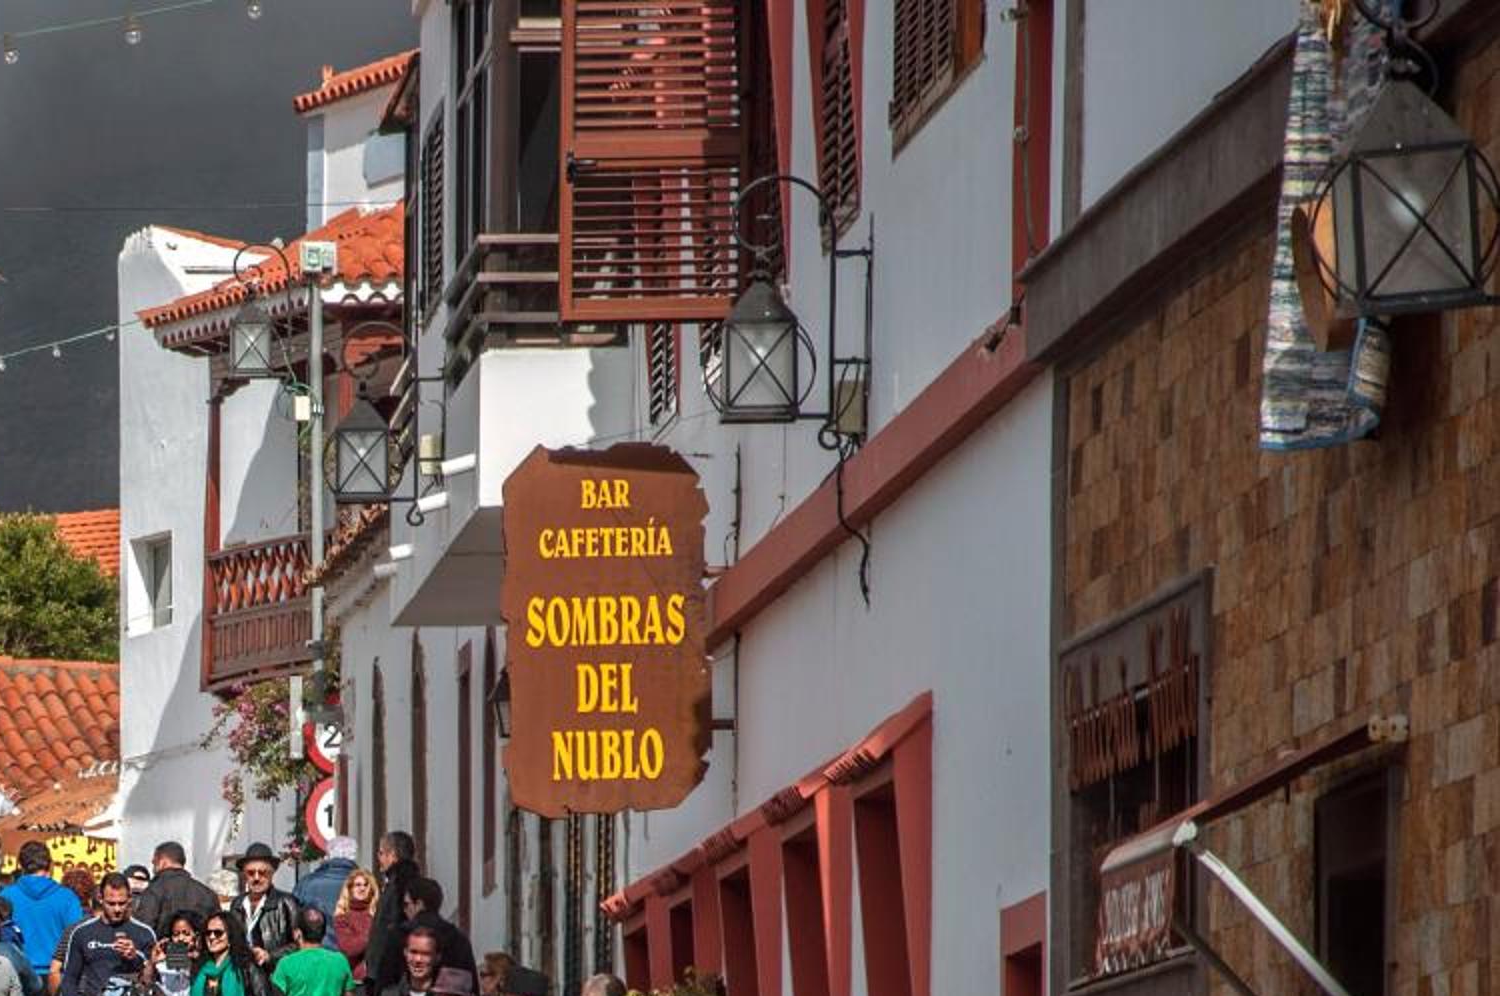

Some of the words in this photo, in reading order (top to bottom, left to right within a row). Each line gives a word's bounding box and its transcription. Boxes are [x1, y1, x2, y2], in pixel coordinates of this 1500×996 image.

[581, 479, 630, 509] BAR
[539, 517, 673, 558] CAFETERÍA
[526, 593, 686, 648] SOMBRAS
[576, 662, 639, 714] DEL
[552, 728, 665, 781] NUBLO
